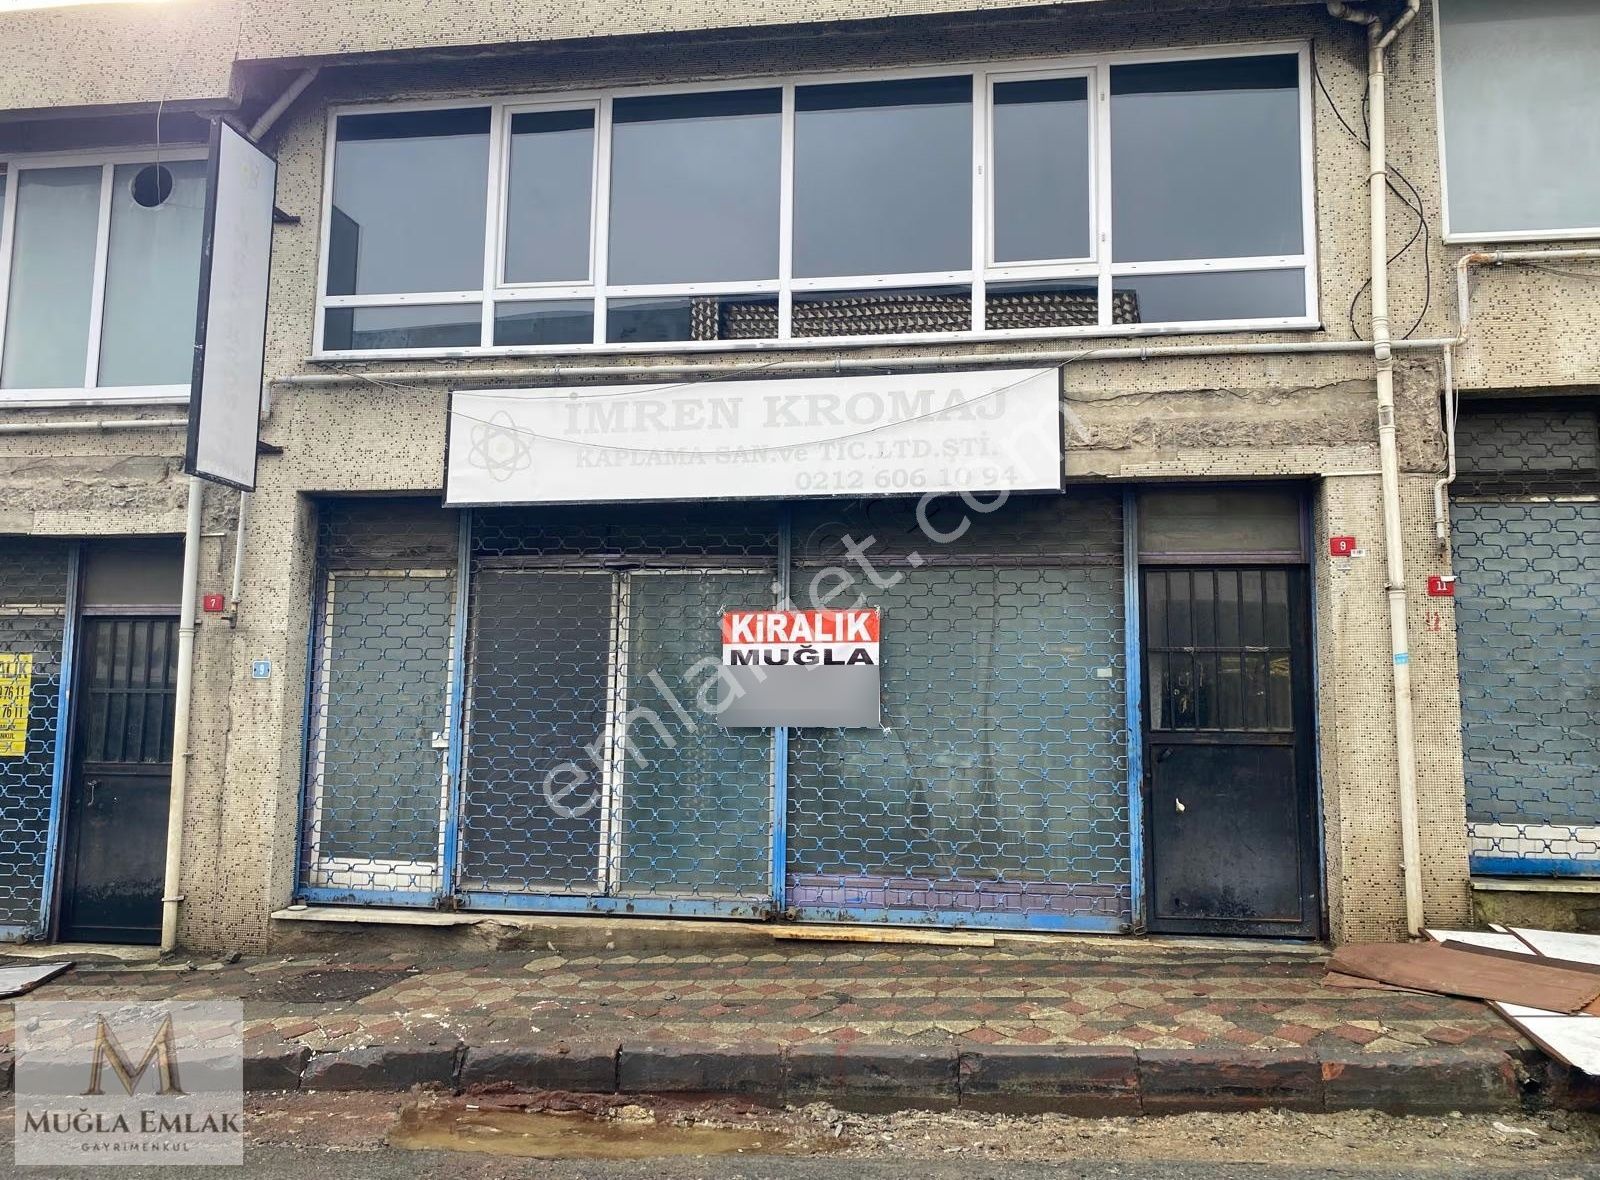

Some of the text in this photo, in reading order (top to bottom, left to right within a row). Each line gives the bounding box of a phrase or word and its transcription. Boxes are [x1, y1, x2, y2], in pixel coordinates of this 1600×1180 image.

[563, 387, 1006, 434] İMREN KROMAJ
[576, 445, 706, 469] KAPLAMA
[795, 469, 864, 491] 0212
[874, 467, 927, 489] 606
[983, 465, 1018, 486] 94
[1339, 540, 1347, 551] 9
[1436, 580, 1449, 591] 11
[730, 644, 874, 666] MUĞLA
